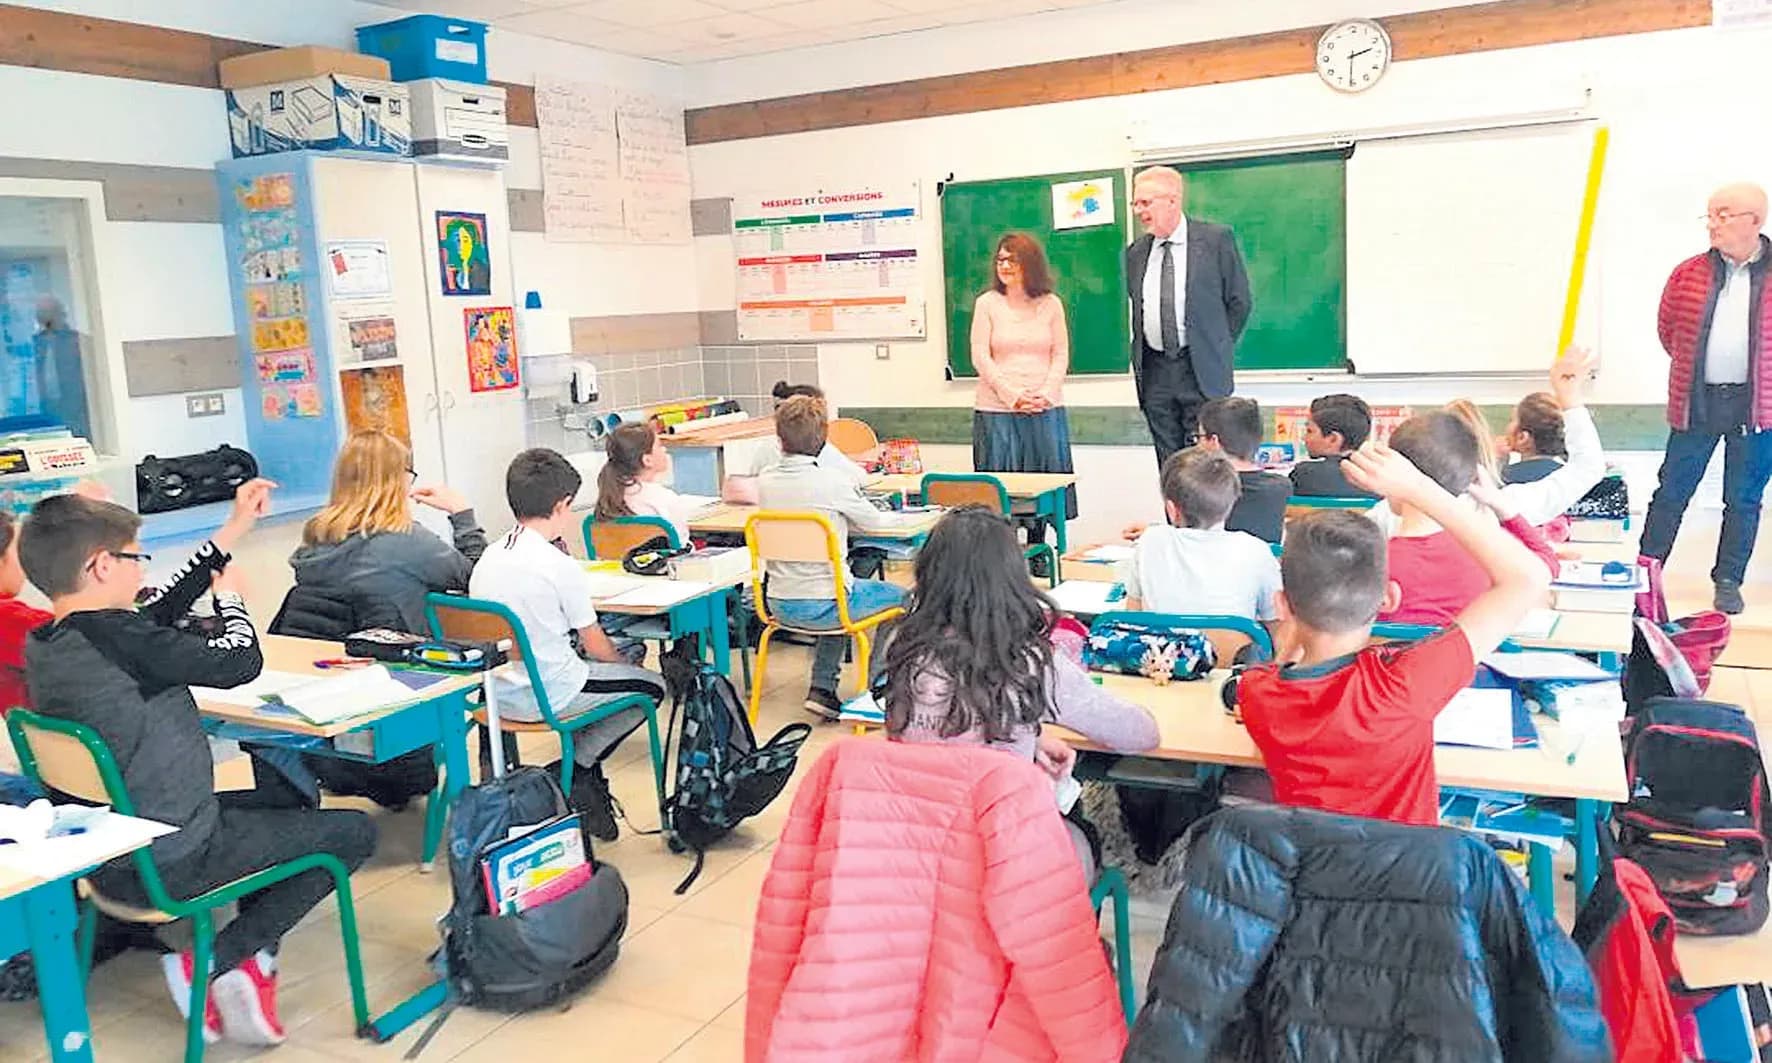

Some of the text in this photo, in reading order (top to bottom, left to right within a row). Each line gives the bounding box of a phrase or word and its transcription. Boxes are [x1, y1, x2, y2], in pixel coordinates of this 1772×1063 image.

[761, 192, 883, 209] MESURES ET CONVERSIONS
